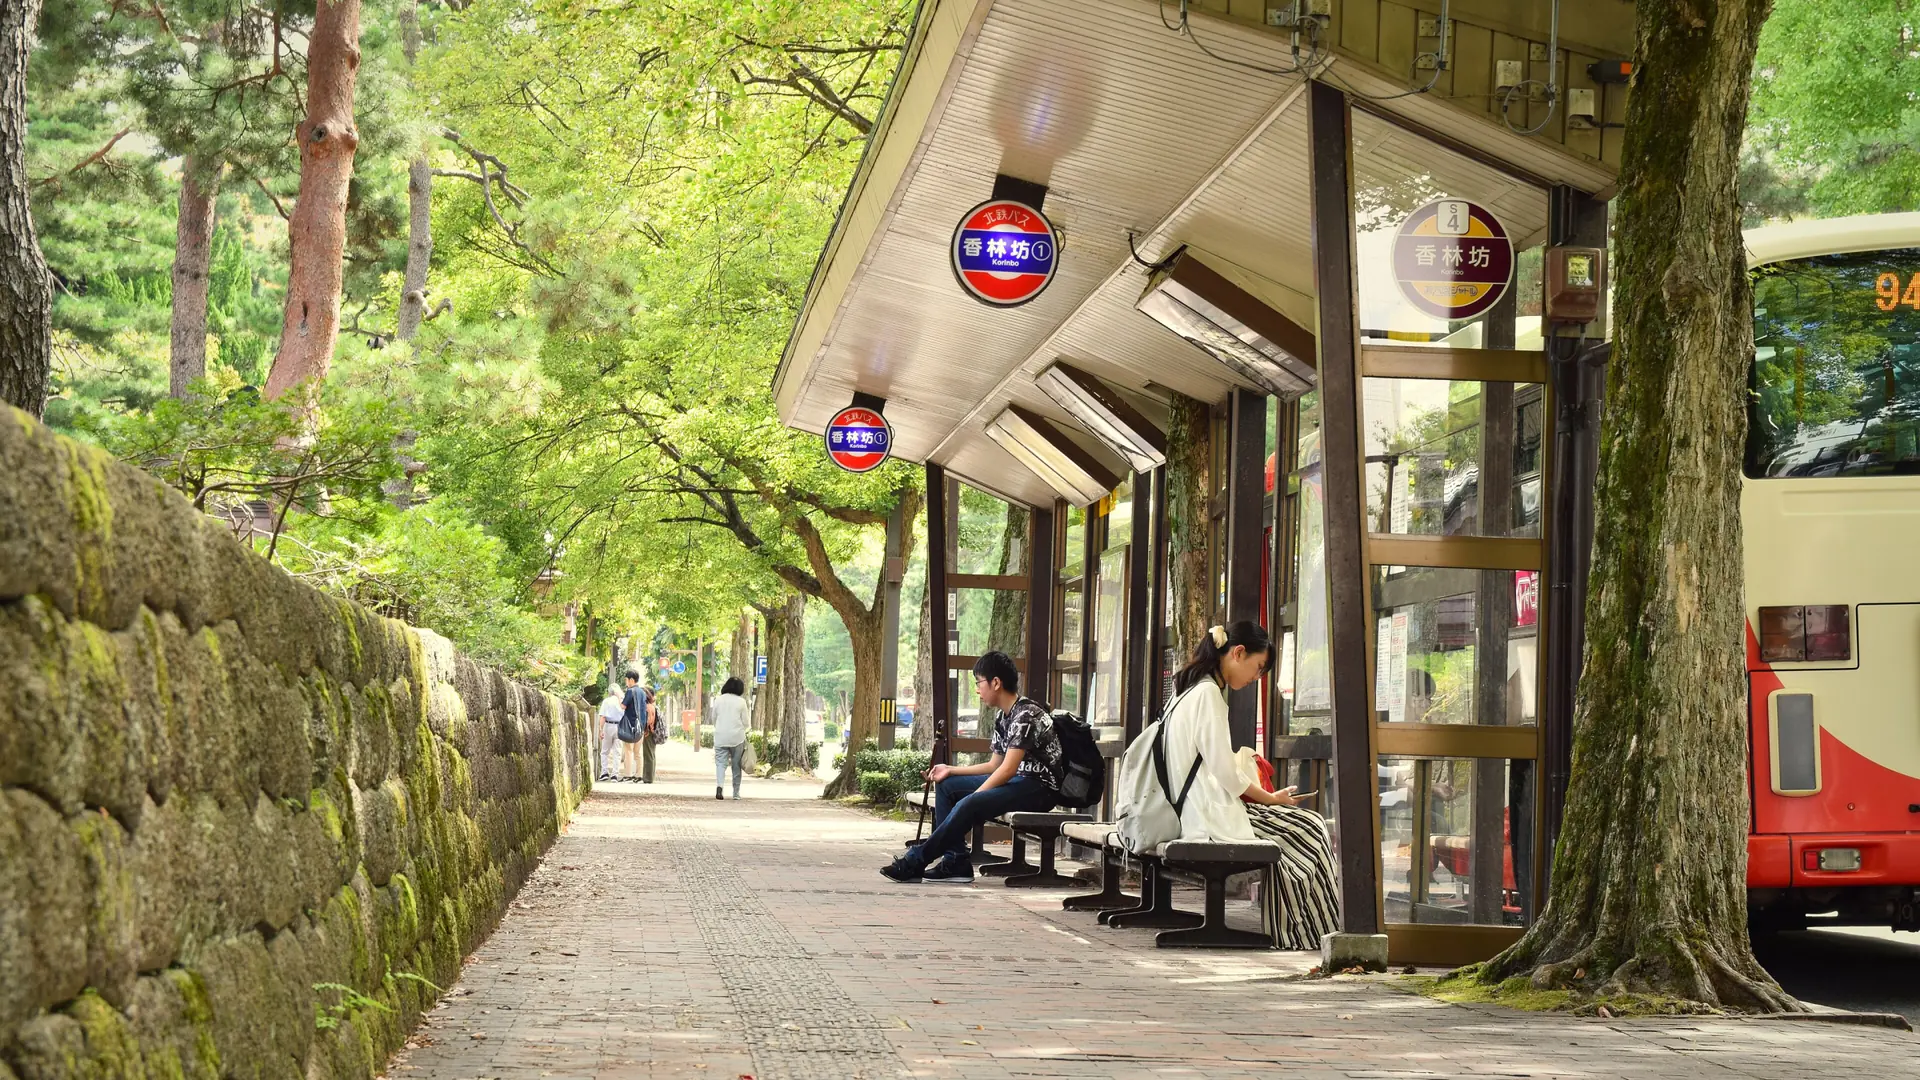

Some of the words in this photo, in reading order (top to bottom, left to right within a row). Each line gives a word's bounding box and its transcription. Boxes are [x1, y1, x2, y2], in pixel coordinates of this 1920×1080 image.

[1449, 204, 1458, 214] S
[982, 208, 1030, 227] 北鉄バス
[1446, 215, 1459, 231] 4
[991, 258, 1020, 267] Korinbo
[1415, 244, 1491, 268] 香林坊
